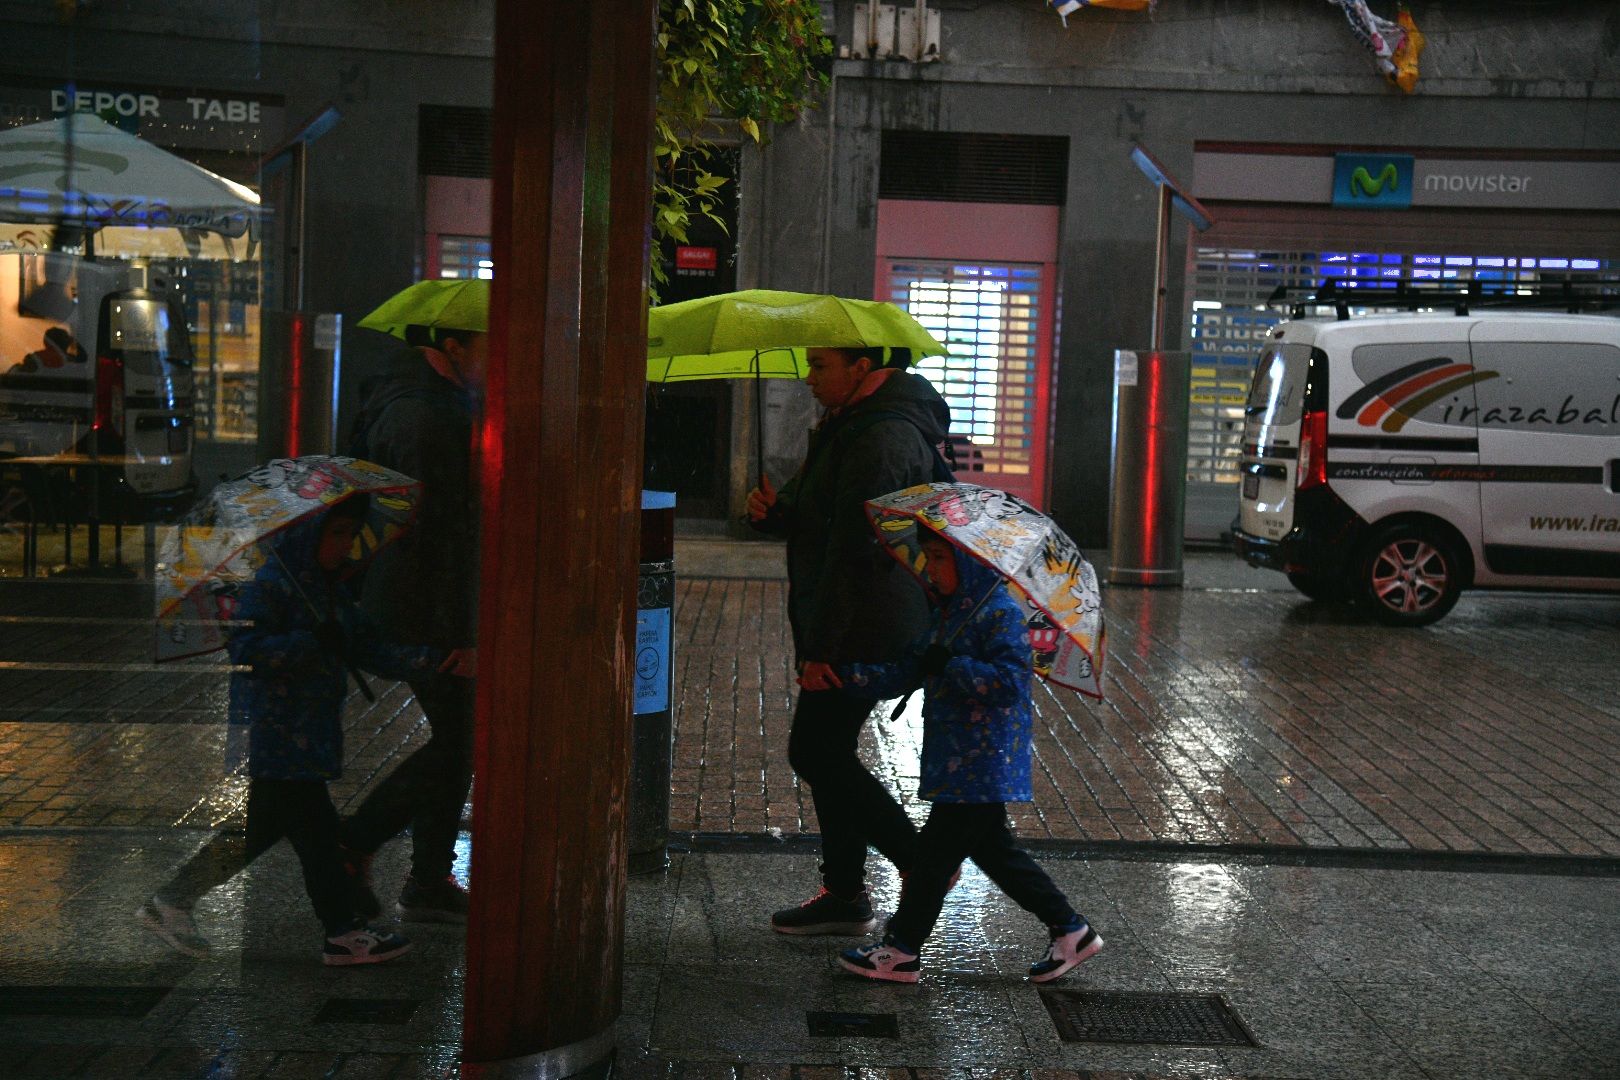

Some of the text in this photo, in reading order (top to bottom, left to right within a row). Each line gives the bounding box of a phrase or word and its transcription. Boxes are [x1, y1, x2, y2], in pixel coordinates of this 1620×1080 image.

[51, 89, 160, 118] DEPOR
[1425, 172, 1531, 193] movistar
[1443, 395, 1620, 425] irazabal
[1530, 514, 1620, 532] www.ira
